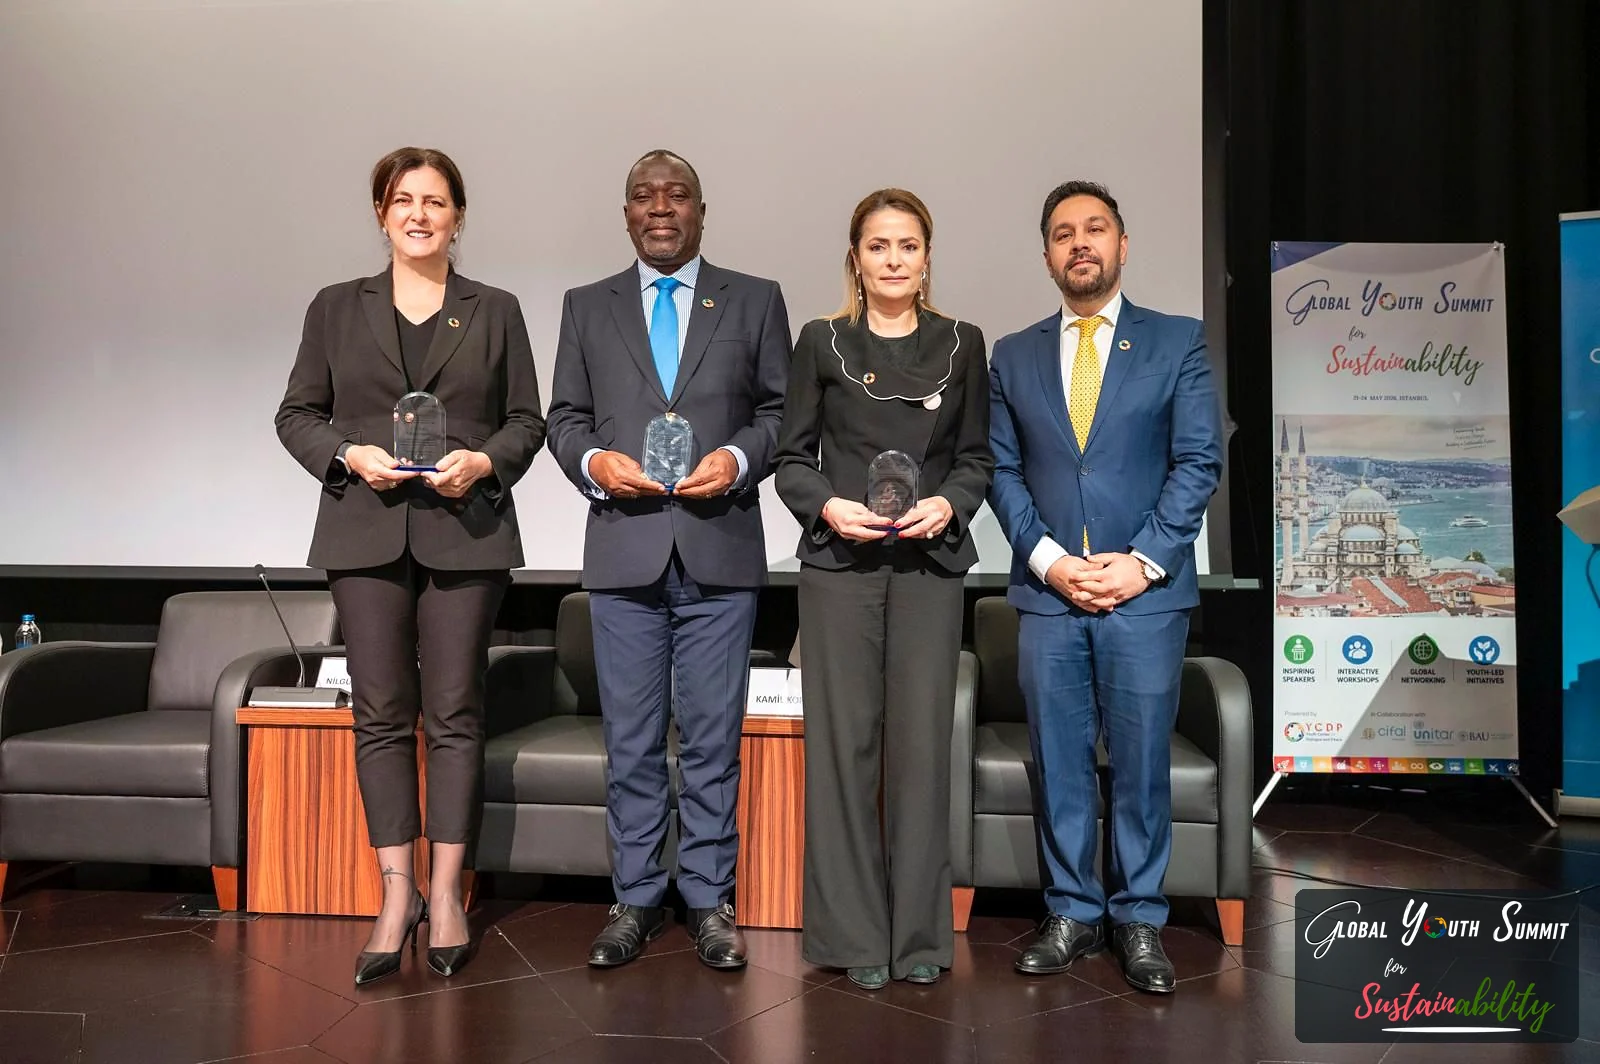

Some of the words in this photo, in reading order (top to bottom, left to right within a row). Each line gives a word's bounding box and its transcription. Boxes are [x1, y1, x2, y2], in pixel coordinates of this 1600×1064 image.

[1349, 326, 1367, 341] for
[1326, 341, 1484, 385] Sustainability
[1410, 668, 1436, 676] GLOBAL
[1336, 676, 1380, 684] WORKSHOPS
[1466, 677, 1505, 685] INITIATIVES
[755, 693, 783, 704] KAMİL
[1378, 725, 1406, 737] cifal
[1414, 728, 1455, 740] unitar
[1469, 731, 1489, 741] BAU
